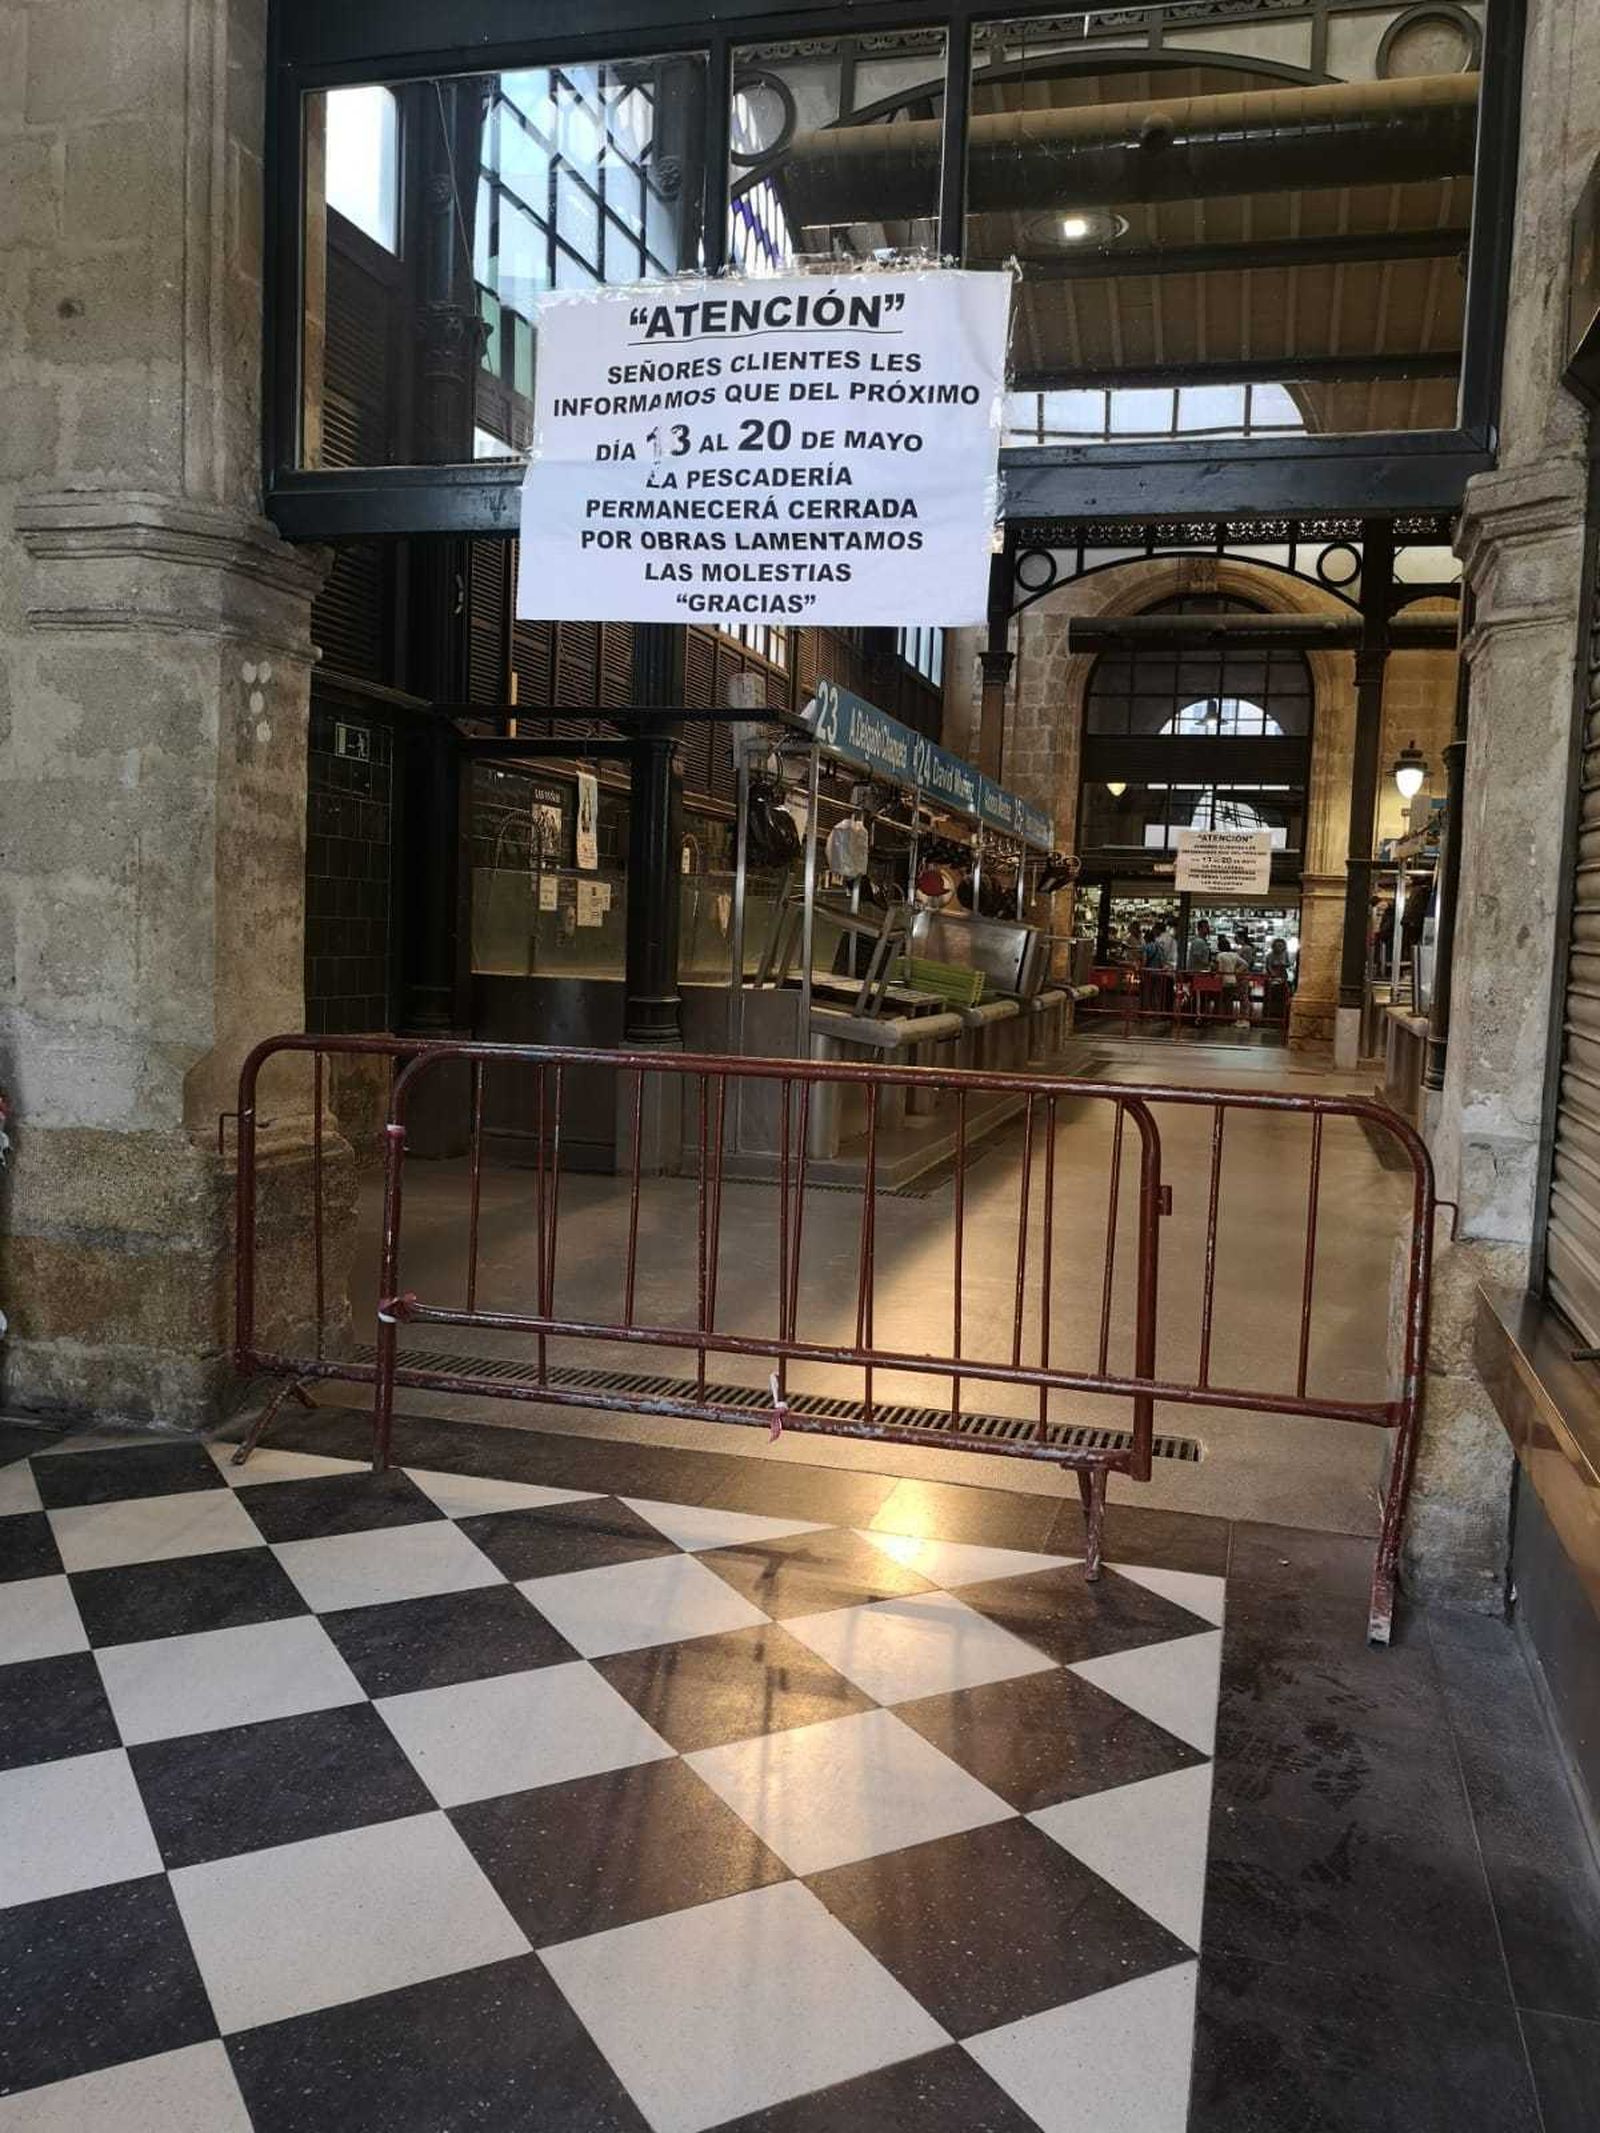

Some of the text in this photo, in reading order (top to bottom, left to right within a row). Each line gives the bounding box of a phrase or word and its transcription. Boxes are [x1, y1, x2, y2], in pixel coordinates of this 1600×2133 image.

[629, 288, 905, 339] “ATENCIÓN”
[607, 350, 922, 385] SEÑORES CLIENTES LES
[553, 379, 980, 417] INFORMAMOS QUE DEL PRÓXIMO
[595, 439, 636, 461] DÍA
[698, 433, 729, 454] AL
[738, 419, 792, 451] 20
[801, 430, 835, 450] DE
[844, 430, 923, 453] MAYO
[645, 461, 853, 490] LA PESCADERÍA
[586, 494, 918, 520] PERMANECERÁ CERRADA
[581, 530, 923, 551] POR OBRAS LAMENTAMOS
[645, 562, 852, 582] LAS MOLESTIAS
[676, 593, 816, 614] “GRACIAS”
[815, 680, 839, 745] 23
